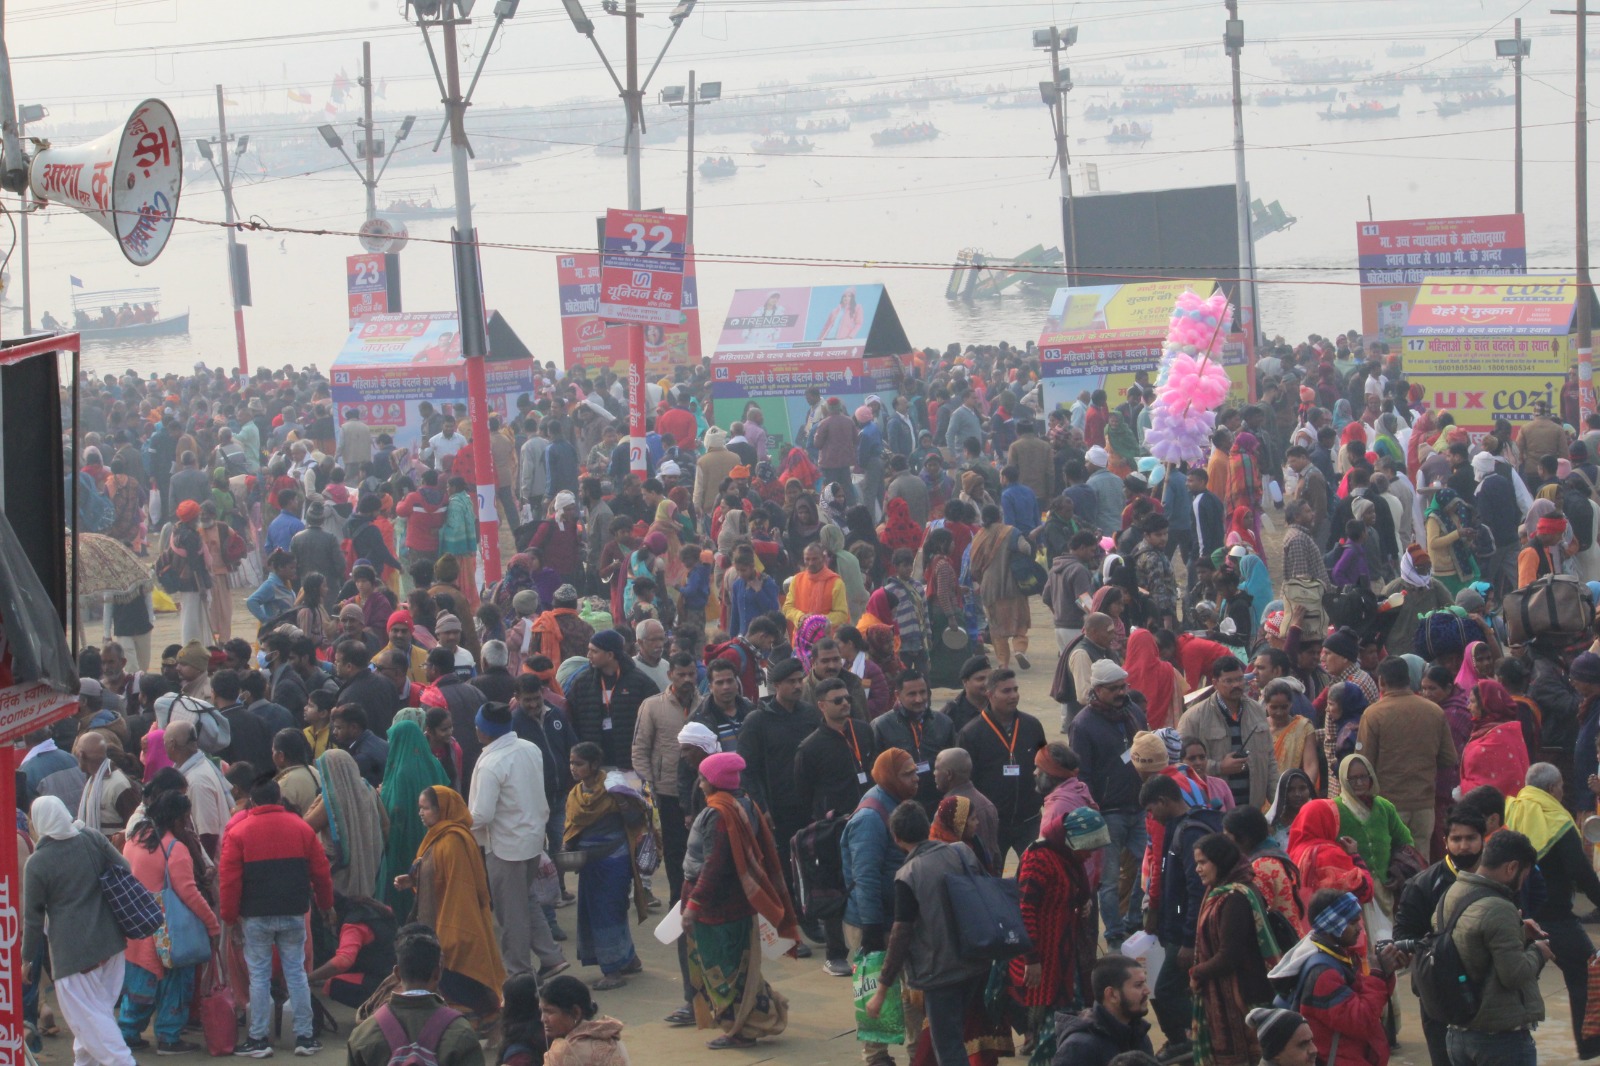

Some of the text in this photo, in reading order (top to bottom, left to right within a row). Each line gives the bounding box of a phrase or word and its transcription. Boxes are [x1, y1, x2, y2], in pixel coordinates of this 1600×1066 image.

[41, 163, 85, 200] आशा
[1364, 226, 1378, 235] 11
[621, 222, 673, 258] 32
[1379, 229, 1506, 248] मा. उच्च न्यायालय के आदेशानुसार
[562, 258, 574, 268] 14
[1385, 247, 1503, 266] स्नान घाट से 100 मी. के अन्दर
[354, 261, 380, 286] 23
[607, 283, 652, 301] यूनियन
[653, 287, 674, 302] बैंक
[1506, 277, 1567, 296] cozi
[1130, 308, 1144, 316] JK
[1431, 304, 1516, 319] चेहरे पे मुस्कान
[741, 315, 789, 325] TRENDS
[581, 323, 603, 338] R.L.
[1417, 326, 1454, 335] महिलाओं
[1487, 326, 1513, 334] बदलने
[1408, 340, 1424, 350] 17
[1428, 337, 1461, 352] महिलाओं
[1463, 337, 1471, 352] के
[1492, 337, 1515, 352] बदलने
[1518, 340, 1529, 351] का
[1531, 340, 1549, 351] स्थान
[718, 351, 754, 361] महिलाओं
[757, 351, 764, 360] के
[786, 350, 811, 359] बदलने
[826, 349, 848, 357] स्थान
[1045, 350, 1060, 359] 03
[1063, 349, 1095, 362] महिलाओं
[1098, 348, 1105, 360] के
[1125, 346, 1148, 358] बदलने
[1150, 347, 1160, 356] का
[335, 373, 349, 383] 21
[716, 368, 728, 379] 04
[735, 369, 843, 385] महिलाओं के वस्त्र बदलने का स्थान
[1056, 365, 1082, 375] महिला
[1084, 365, 1109, 376] पुलिस
[352, 375, 379, 389] महिलाओं
[380, 376, 387, 388] के
[402, 374, 422, 387] बदलने
[423, 377, 431, 387] का
[432, 376, 448, 387] स्थान
[1493, 382, 1557, 411] cozi
[0, 705, 36, 727] comes
[36, 696, 58, 715] you
